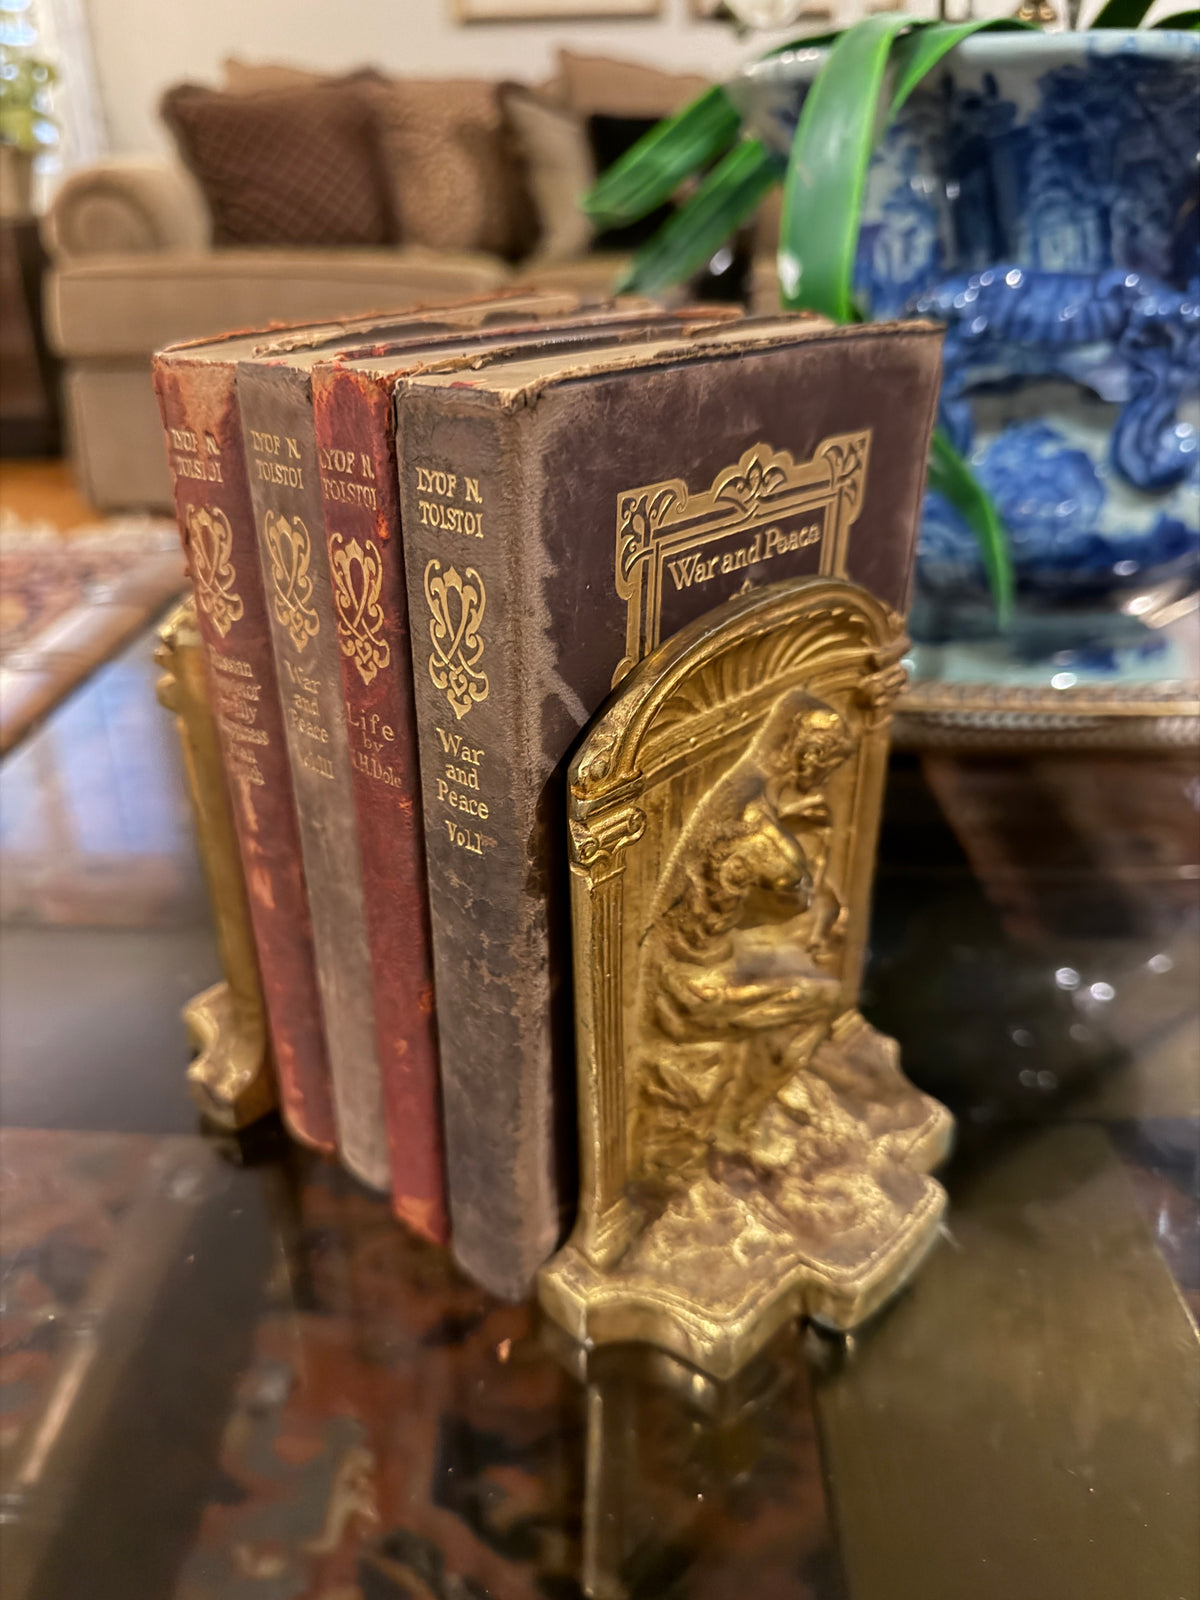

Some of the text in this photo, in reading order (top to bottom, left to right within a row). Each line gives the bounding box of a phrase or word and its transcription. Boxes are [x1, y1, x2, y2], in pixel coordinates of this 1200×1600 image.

[255, 459, 304, 490] TOLSTOI
[416, 467, 456, 498] LYOF
[322, 477, 377, 511] TOLSTOI
[419, 501, 484, 539] TOLSTOI
[667, 521, 822, 591] War and Peace
[294, 694, 320, 716] and
[346, 702, 395, 741] Life
[288, 708, 329, 743] Peace
[436, 727, 485, 766] War
[445, 763, 480, 790] and
[436, 778, 489, 819] Peace
